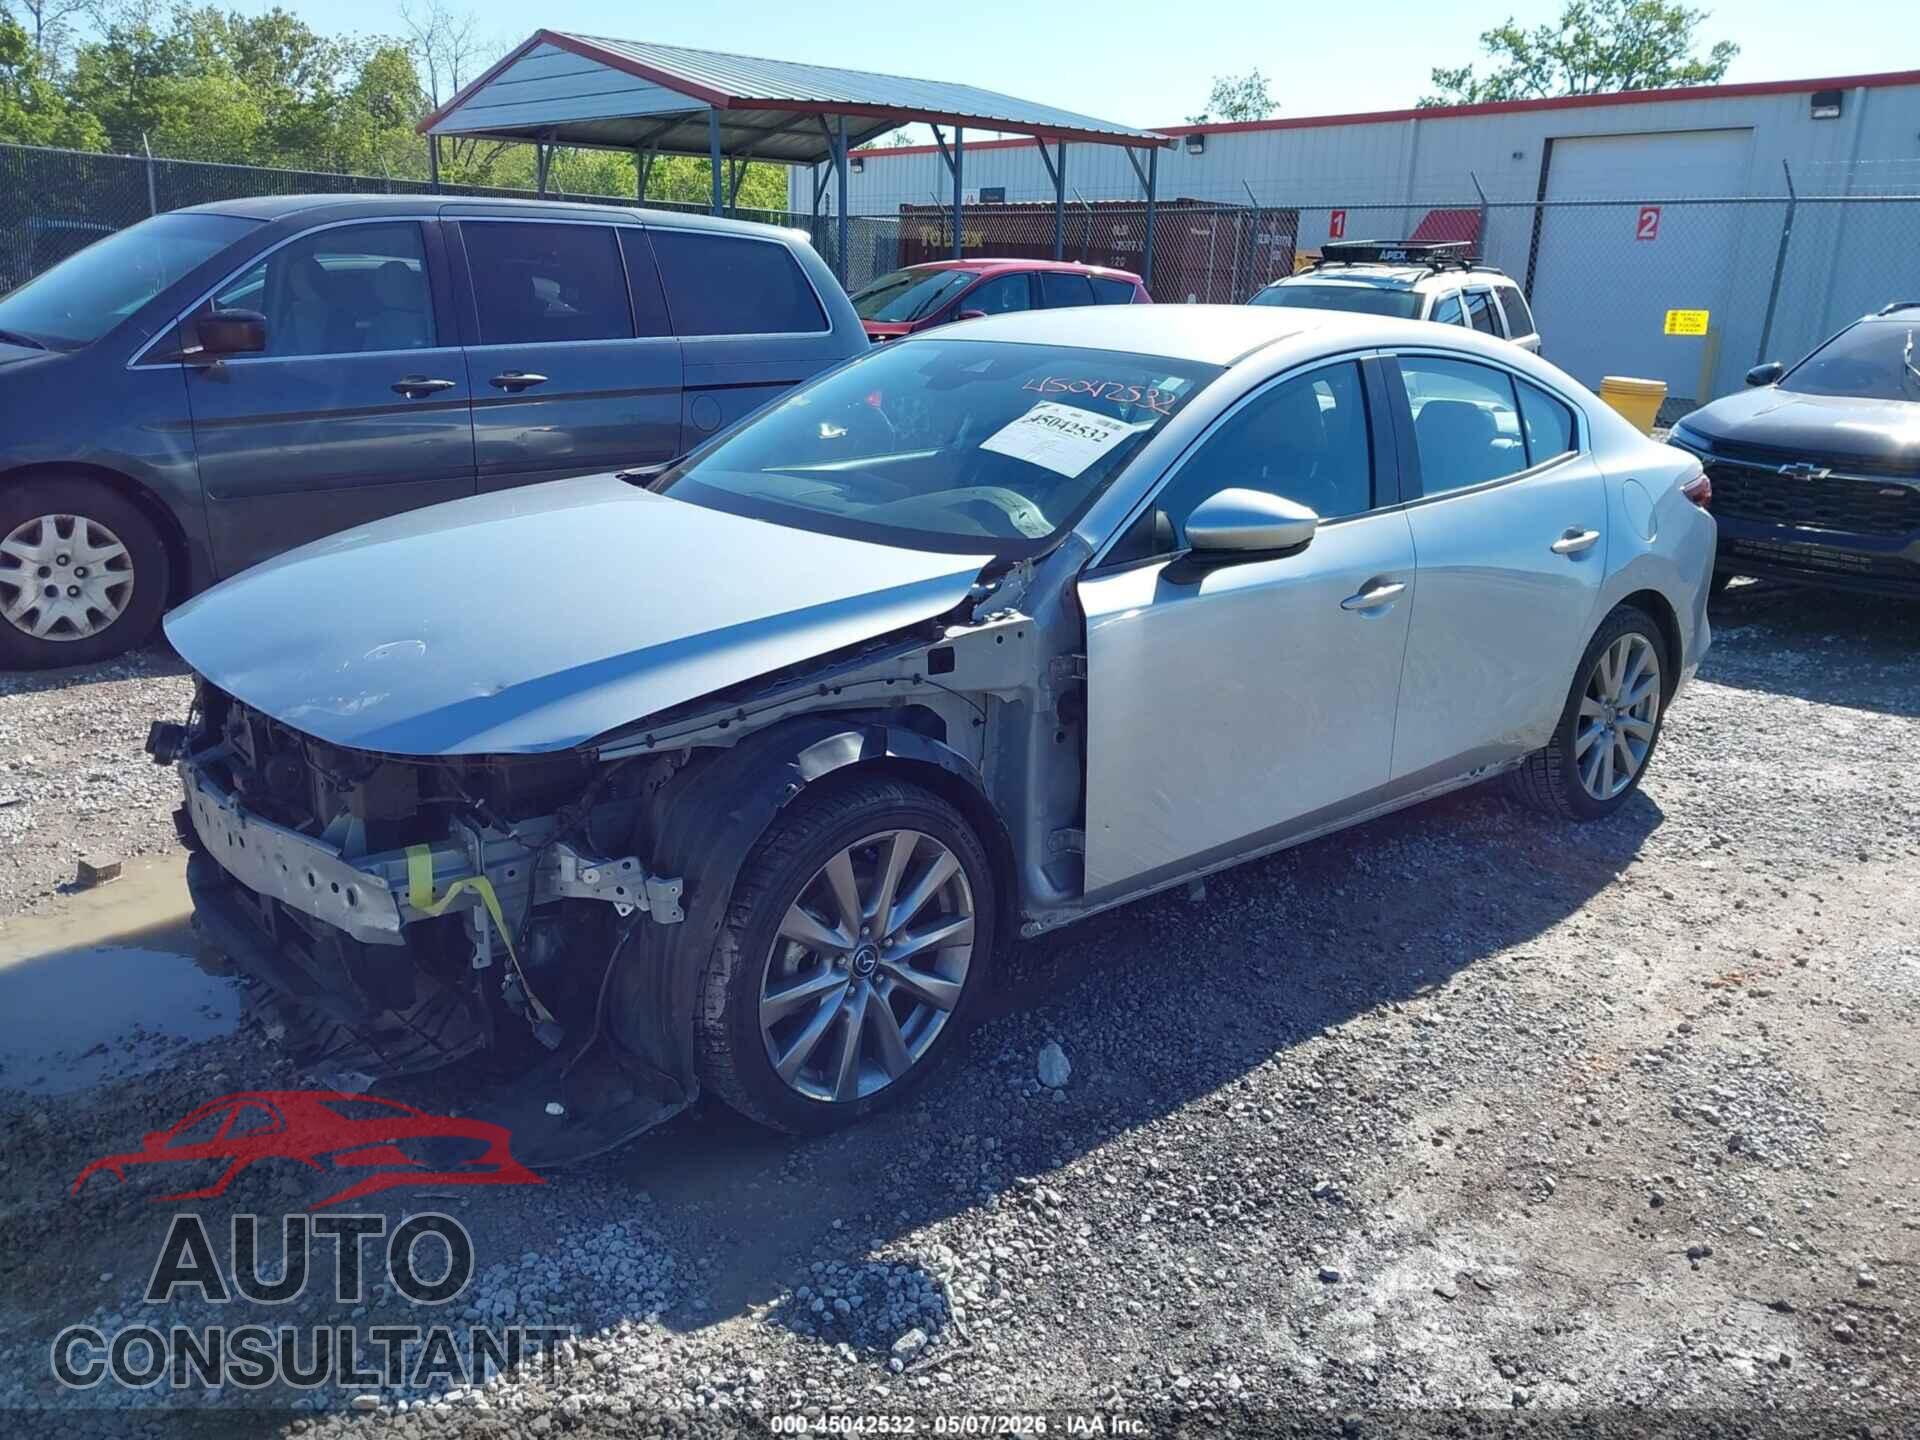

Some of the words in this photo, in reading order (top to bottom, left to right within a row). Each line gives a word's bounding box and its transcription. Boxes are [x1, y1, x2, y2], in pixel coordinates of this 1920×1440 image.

[1332, 213, 1344, 235] 1
[1639, 210, 1659, 238] 2
[1379, 249, 1407, 261] APEX
[1022, 377, 1176, 415] 45042532
[1023, 414, 1109, 442] 45042532
